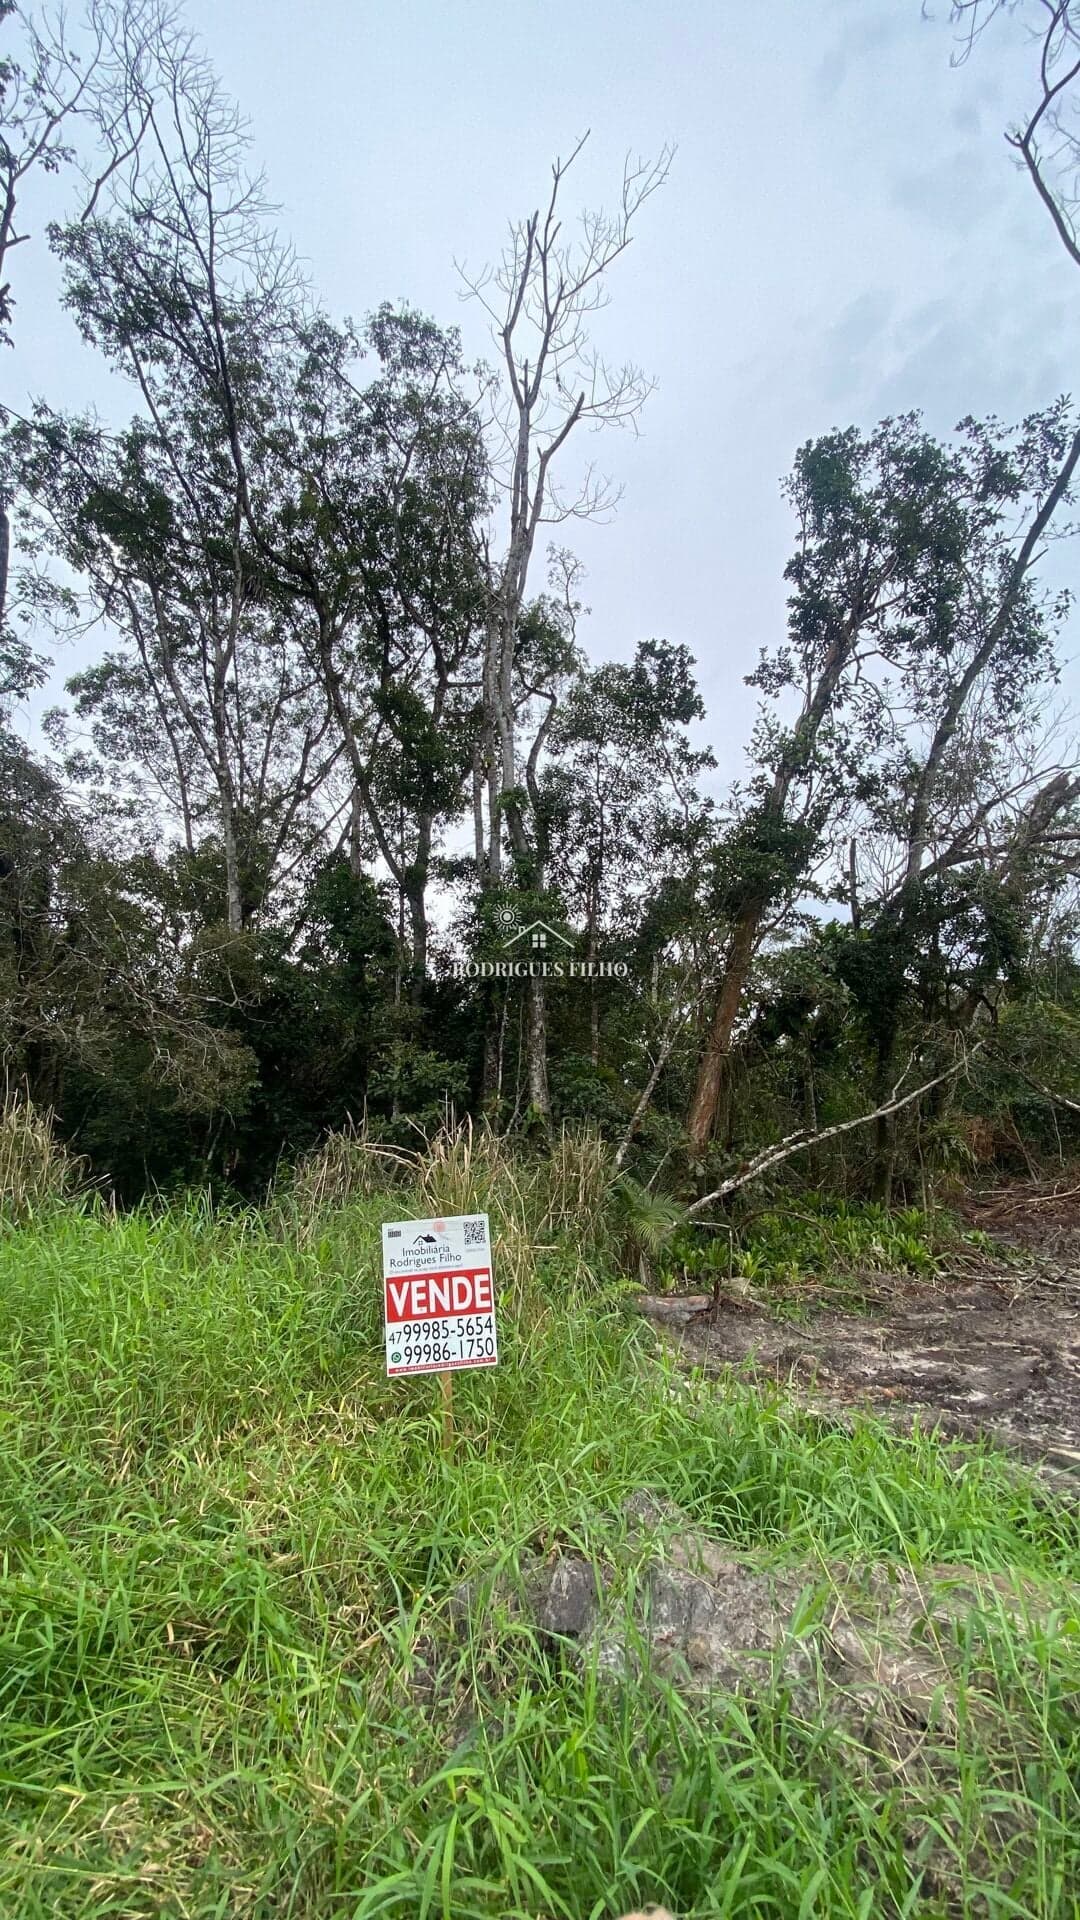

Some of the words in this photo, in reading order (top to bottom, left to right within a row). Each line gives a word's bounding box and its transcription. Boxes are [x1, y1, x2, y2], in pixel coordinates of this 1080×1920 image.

[389, 1257, 437, 1268] Rodrigues
[439, 1253, 462, 1262] Filho
[388, 1274, 491, 1317] VENDE
[389, 1331, 402, 1344] 47
[403, 1315, 493, 1342] 99985-5654
[404, 1337, 494, 1365] 99986-1750
